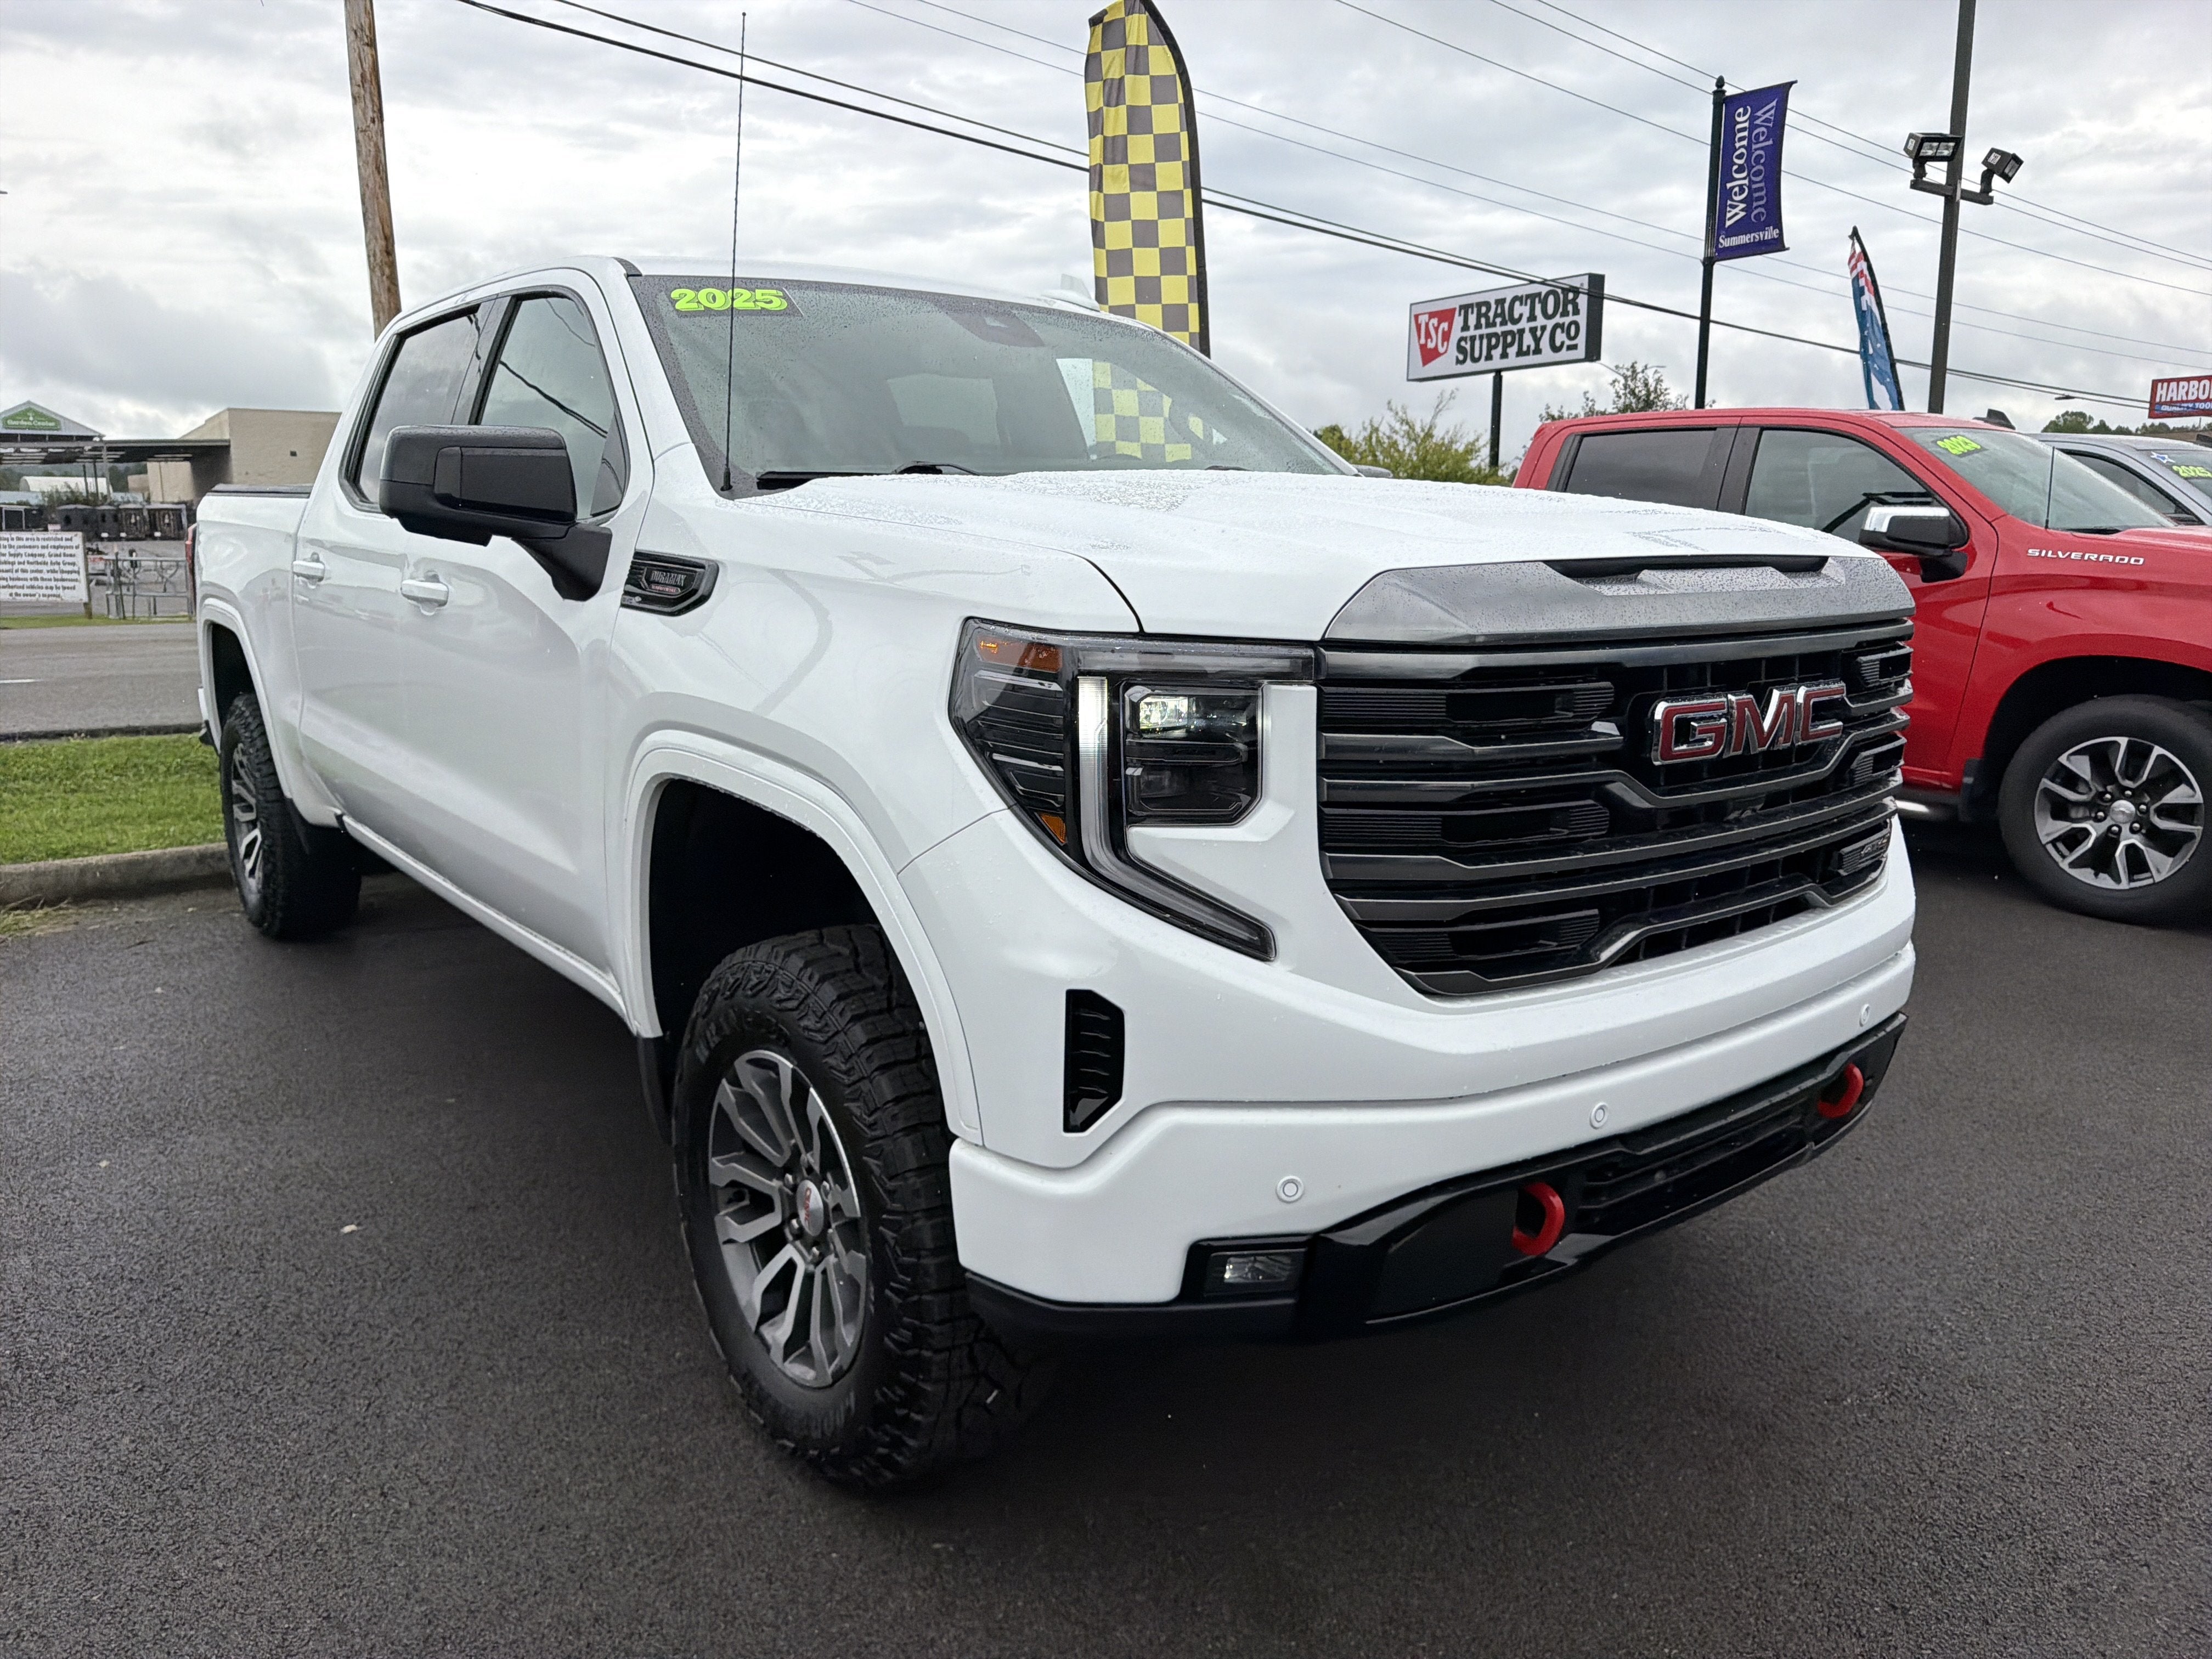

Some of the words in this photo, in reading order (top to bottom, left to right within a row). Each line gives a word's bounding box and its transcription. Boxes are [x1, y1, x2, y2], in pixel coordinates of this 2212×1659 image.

[1725, 105, 1751, 228] Welcome
[1750, 98, 1778, 223] Welcome
[1719, 225, 1780, 249] Summersville
[670, 288, 788, 311] 2025
[1458, 287, 1581, 332] TRACTOR
[1418, 314, 1448, 354] TSC
[1455, 325, 1547, 365] SUPPLY
[2155, 380, 2212, 402] HARBO
[2027, 549, 2145, 565] SILVERADO
[1652, 682, 1846, 765] GMC
